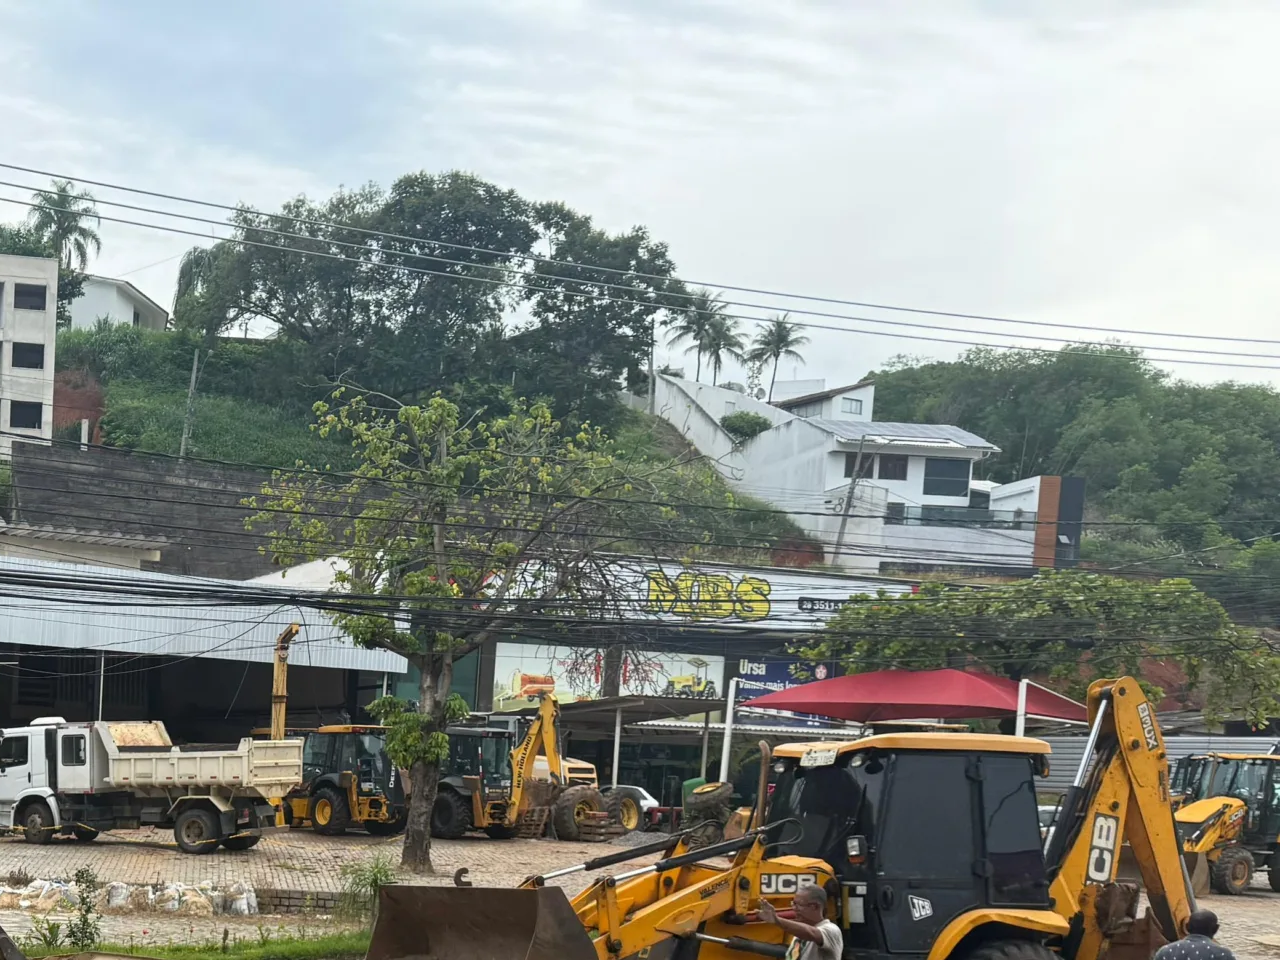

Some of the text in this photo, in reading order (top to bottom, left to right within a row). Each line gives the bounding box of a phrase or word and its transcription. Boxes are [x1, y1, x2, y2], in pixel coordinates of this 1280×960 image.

[739, 658, 766, 676] Ursa
[519, 735, 533, 771] HOLLAND
[911, 897, 933, 919] JCB
